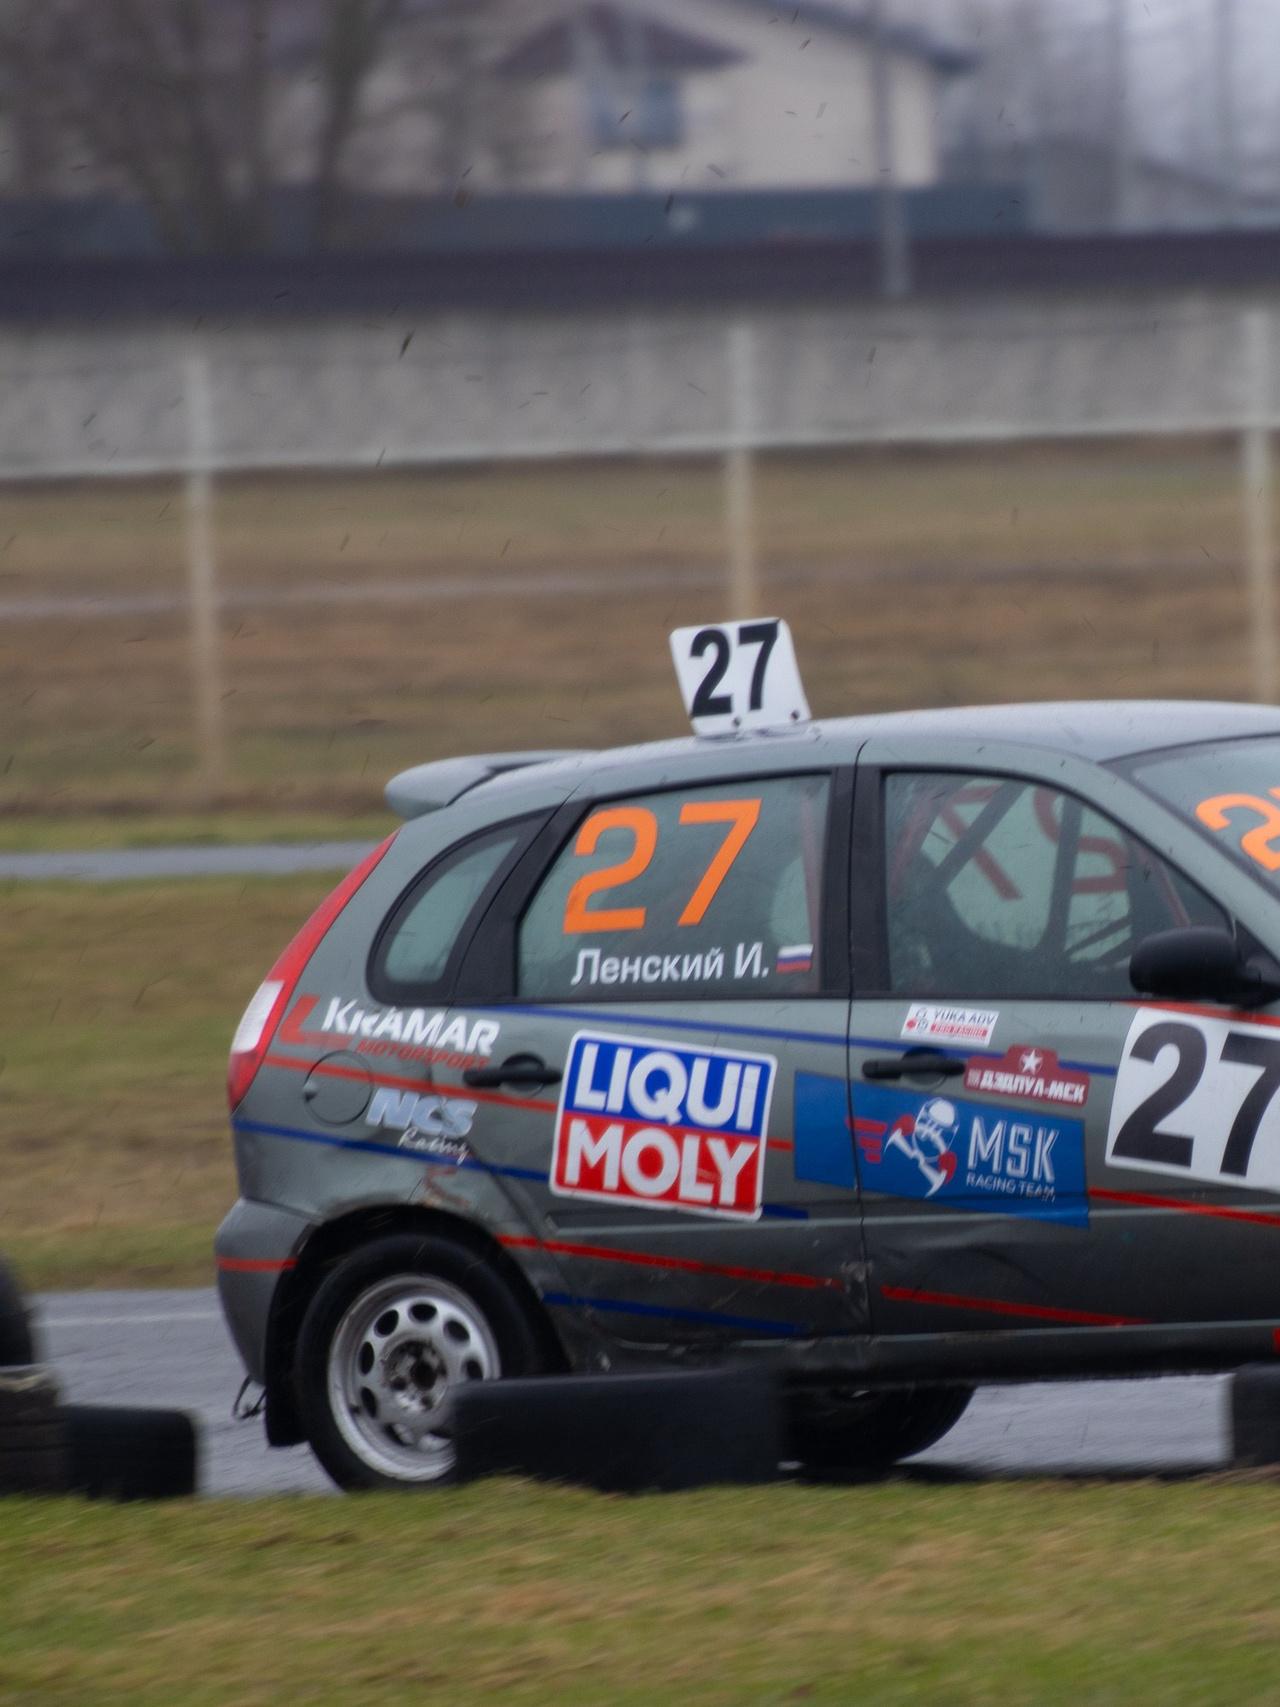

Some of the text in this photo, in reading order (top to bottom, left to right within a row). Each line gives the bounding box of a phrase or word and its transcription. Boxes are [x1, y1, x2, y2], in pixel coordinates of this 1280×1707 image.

[689, 619, 781, 718] 27
[562, 798, 763, 934] 27
[570, 941, 770, 986] Ленский И.
[354, 1037, 491, 1072] MOTORSPORT
[573, 1042, 762, 1131] LIQUI
[365, 1086, 479, 1139] NCS
[564, 1118, 759, 1207] MOLY
[967, 1116, 1060, 1184] MSK
[966, 1172, 1056, 1203] RACING TEAM
